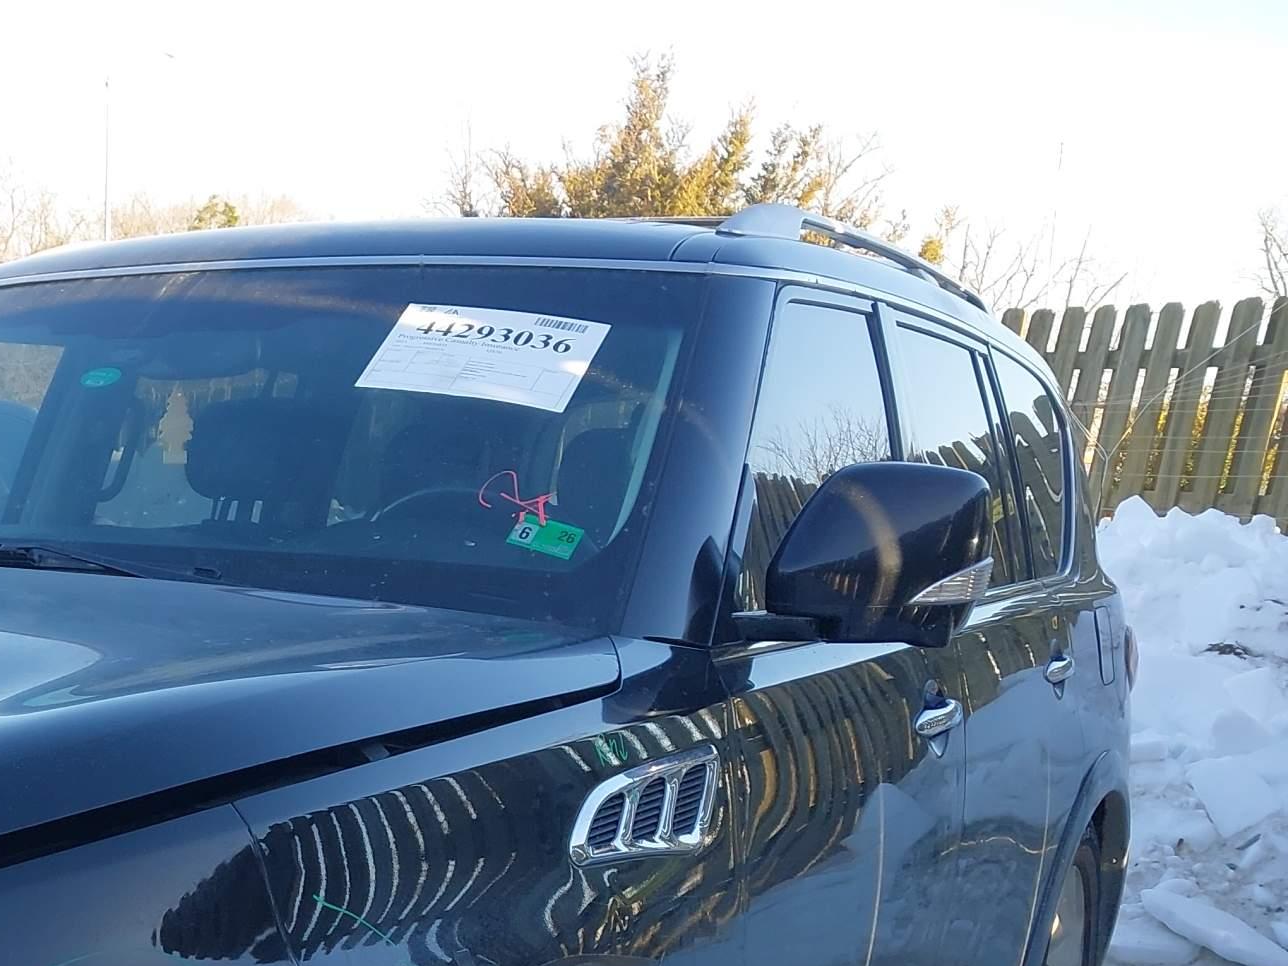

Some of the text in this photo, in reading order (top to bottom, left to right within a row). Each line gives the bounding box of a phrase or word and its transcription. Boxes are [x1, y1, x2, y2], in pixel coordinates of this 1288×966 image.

[416, 320, 577, 354] 44293036
[444, 337, 479, 347] Casualty
[480, 341, 521, 352] Insurance
[518, 526, 533, 540] 6
[557, 530, 577, 544] 26
